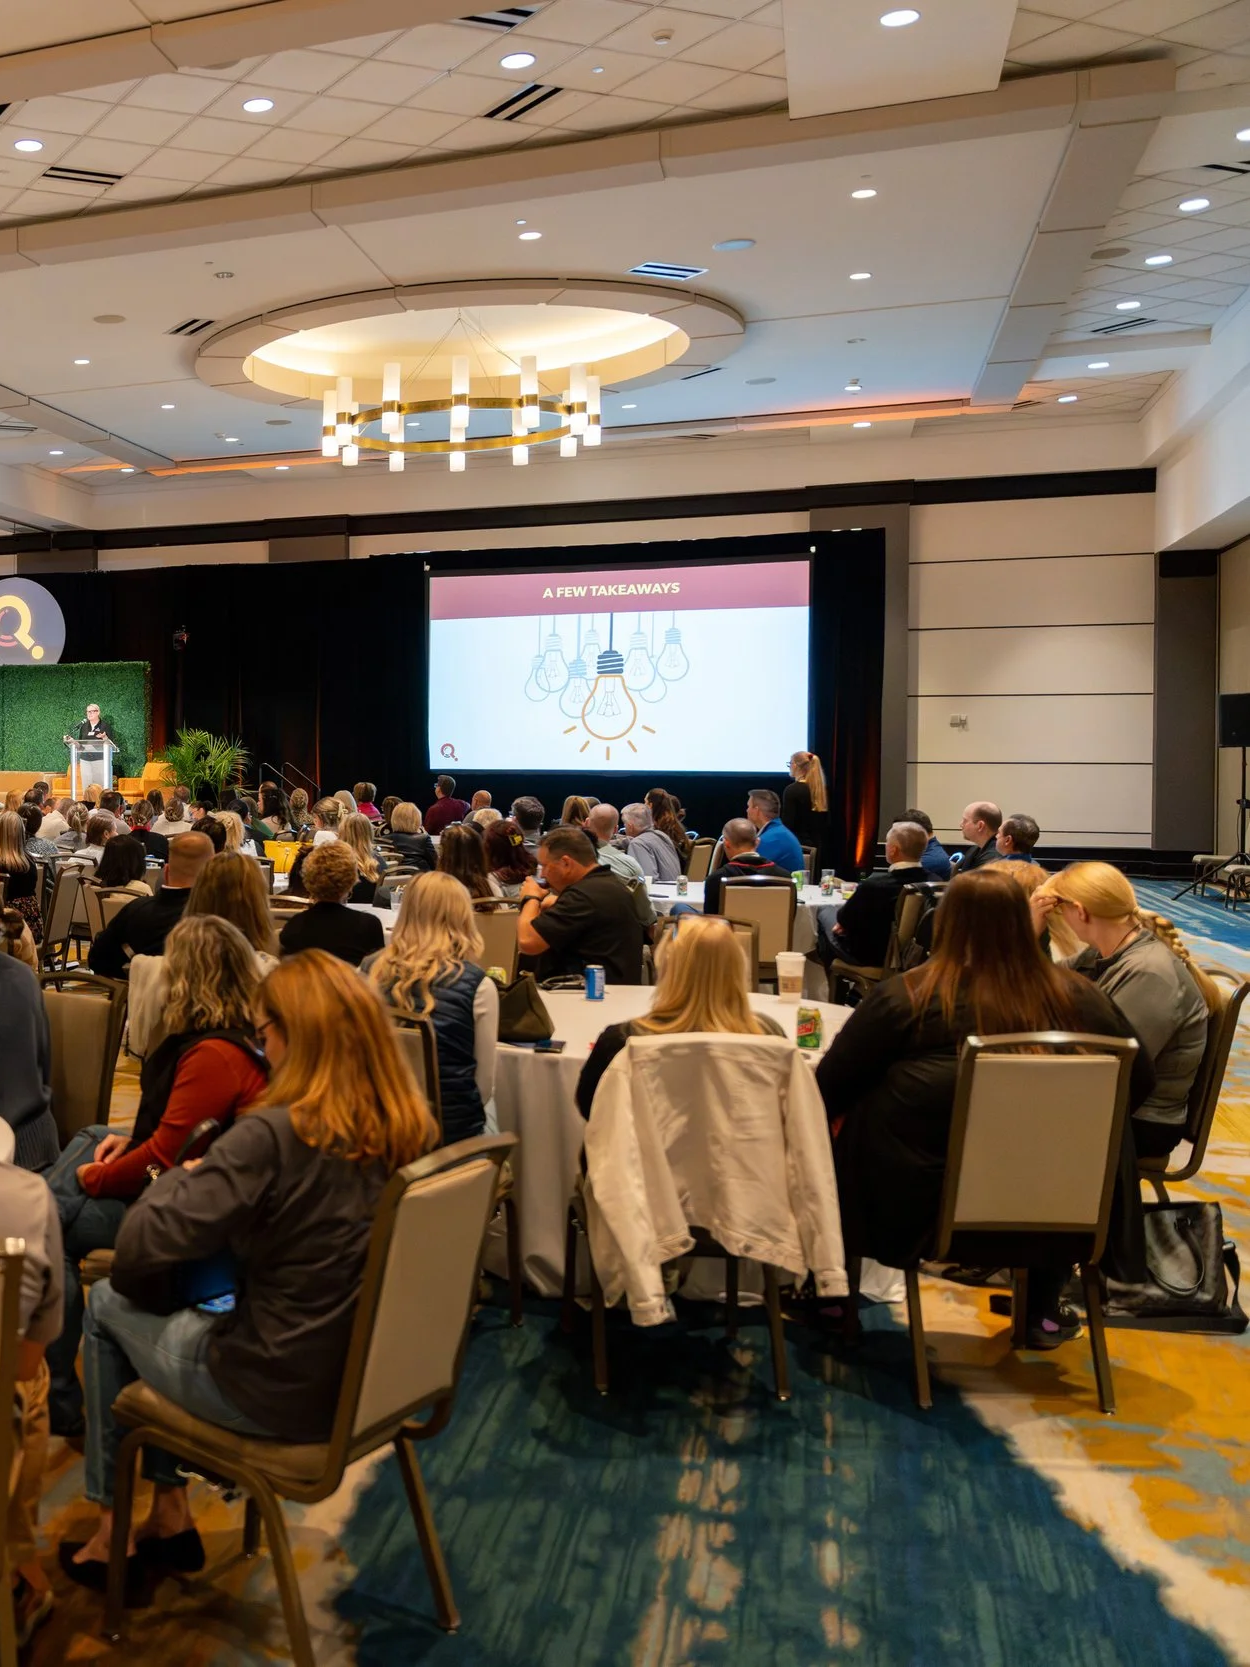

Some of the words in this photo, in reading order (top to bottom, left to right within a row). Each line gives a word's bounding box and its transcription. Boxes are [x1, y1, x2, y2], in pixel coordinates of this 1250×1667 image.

[543, 588, 553, 598] A
[556, 586, 587, 597] FEW
[590, 582, 680, 596] TAKEAWAYS
